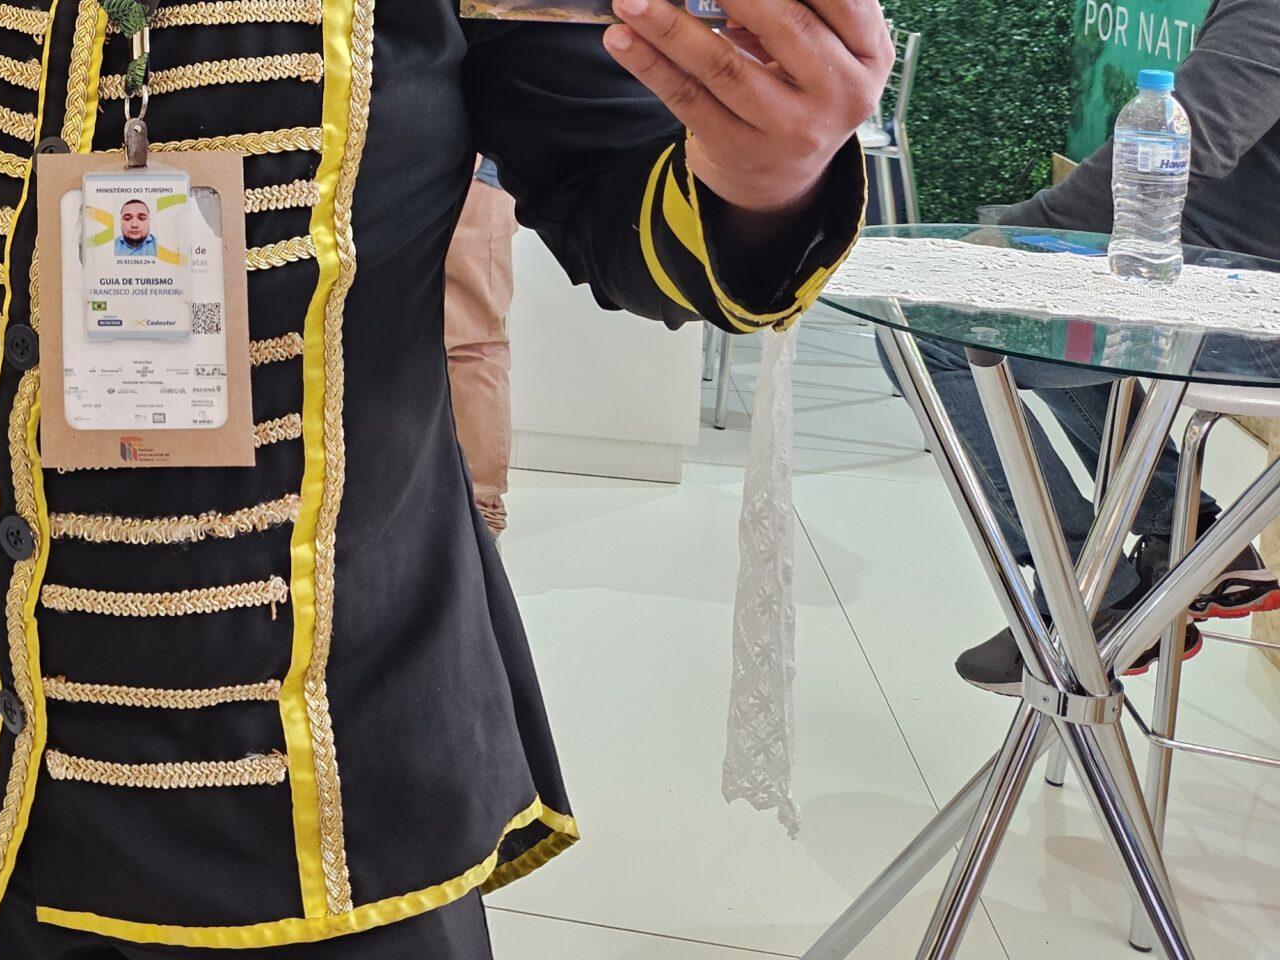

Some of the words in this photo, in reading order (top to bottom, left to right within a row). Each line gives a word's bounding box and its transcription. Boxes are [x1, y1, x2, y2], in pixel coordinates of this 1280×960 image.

[1084, 0, 1129, 47] POR
[100, 278, 120, 286] GUIA
[122, 278, 133, 286] DE
[135, 278, 174, 286] TURISMO
[131, 287, 148, 296] JOSÉ
